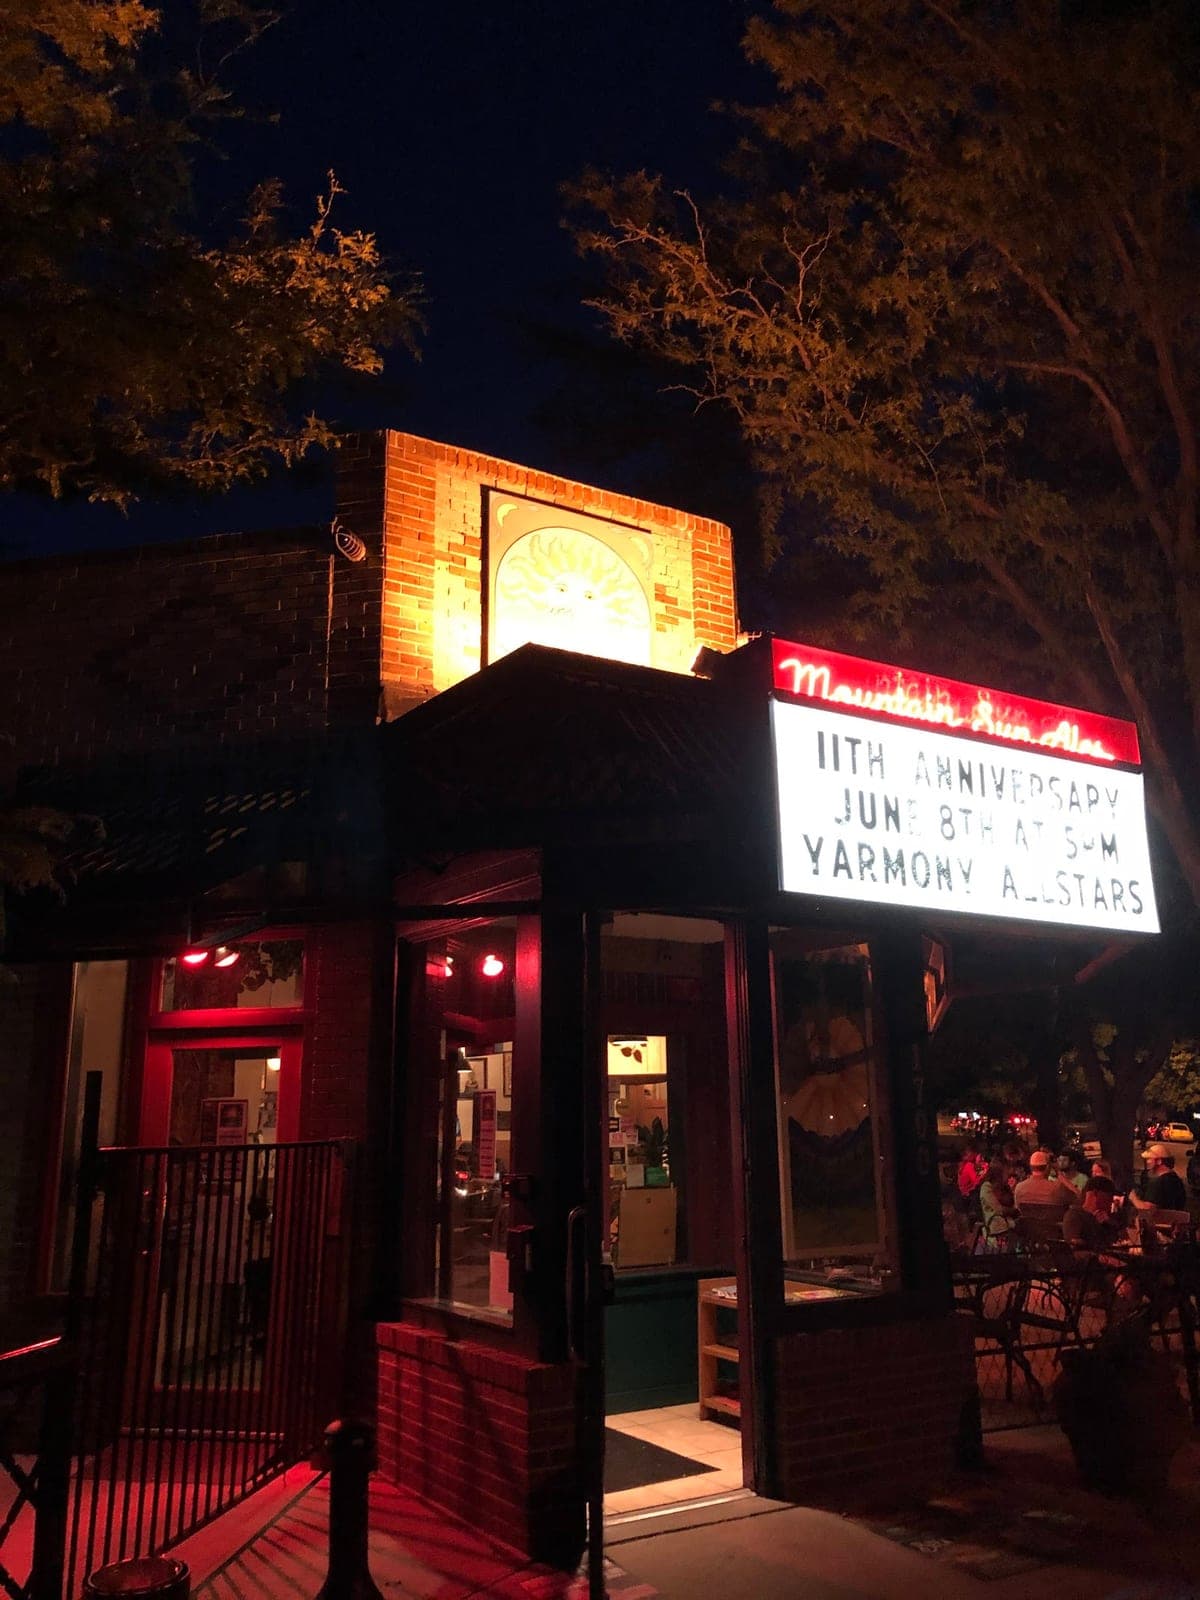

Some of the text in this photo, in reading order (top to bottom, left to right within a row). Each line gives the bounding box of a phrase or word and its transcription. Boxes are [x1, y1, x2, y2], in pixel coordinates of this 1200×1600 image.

[778, 657, 965, 728] Mountain
[971, 699, 1033, 742] Sun
[817, 730, 1118, 819] 11TH ANNIVERSARY
[834, 787, 921, 838] JUNE
[939, 803, 993, 846] 8TH
[1015, 818, 1044, 851] AT
[802, 833, 973, 895] YARMONY
